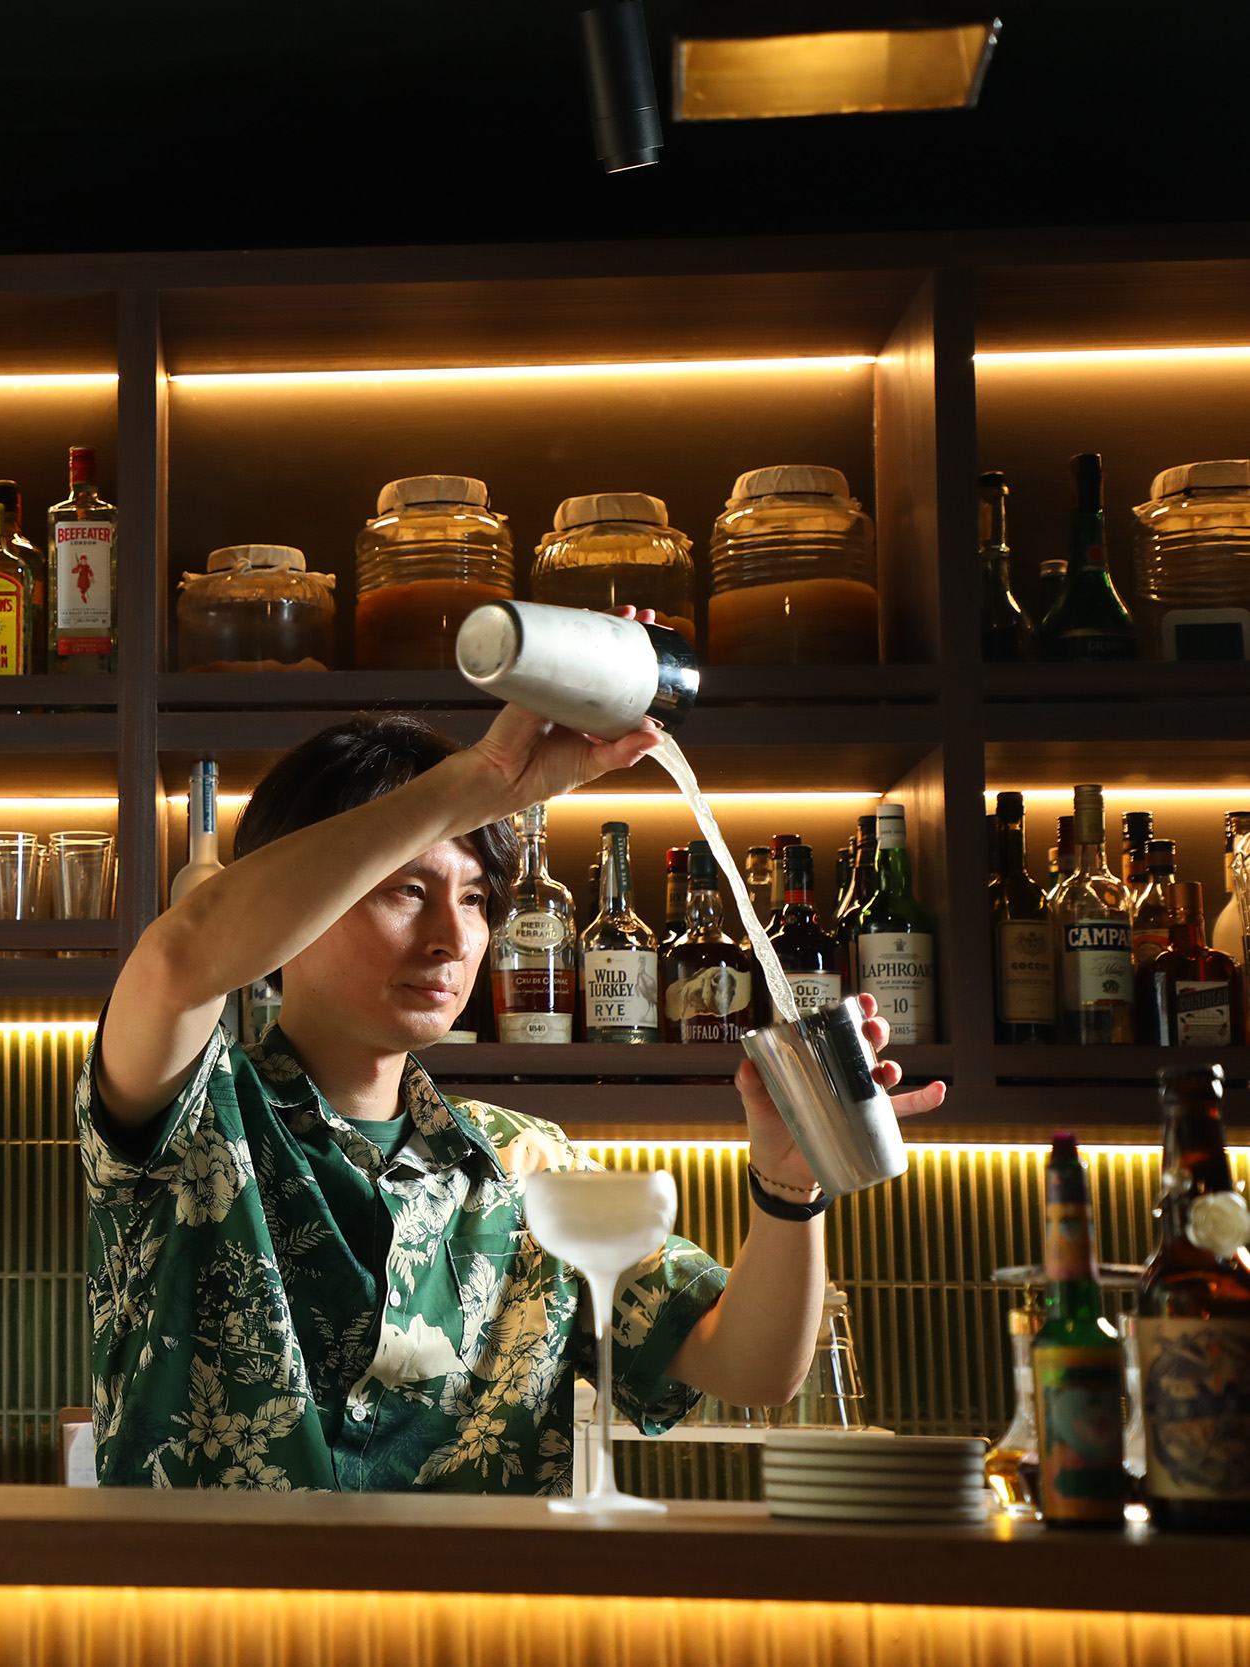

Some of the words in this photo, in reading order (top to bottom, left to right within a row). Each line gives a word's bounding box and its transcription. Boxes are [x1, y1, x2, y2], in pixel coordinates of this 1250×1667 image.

[58, 527, 111, 544] BEEFEATER
[520, 921, 554, 930] PIERRE
[515, 929, 559, 940] FERRAND
[515, 976, 532, 986] CRU
[532, 977, 542, 985] DE
[594, 968, 628, 984] WILD
[588, 981, 634, 998] TURKEY
[796, 985, 820, 996] OLD
[595, 1003, 626, 1016] RYE
[893, 997, 909, 1014] 10
[529, 1023, 546, 1033] 1840
[681, 1023, 720, 1041] BUFFALO
